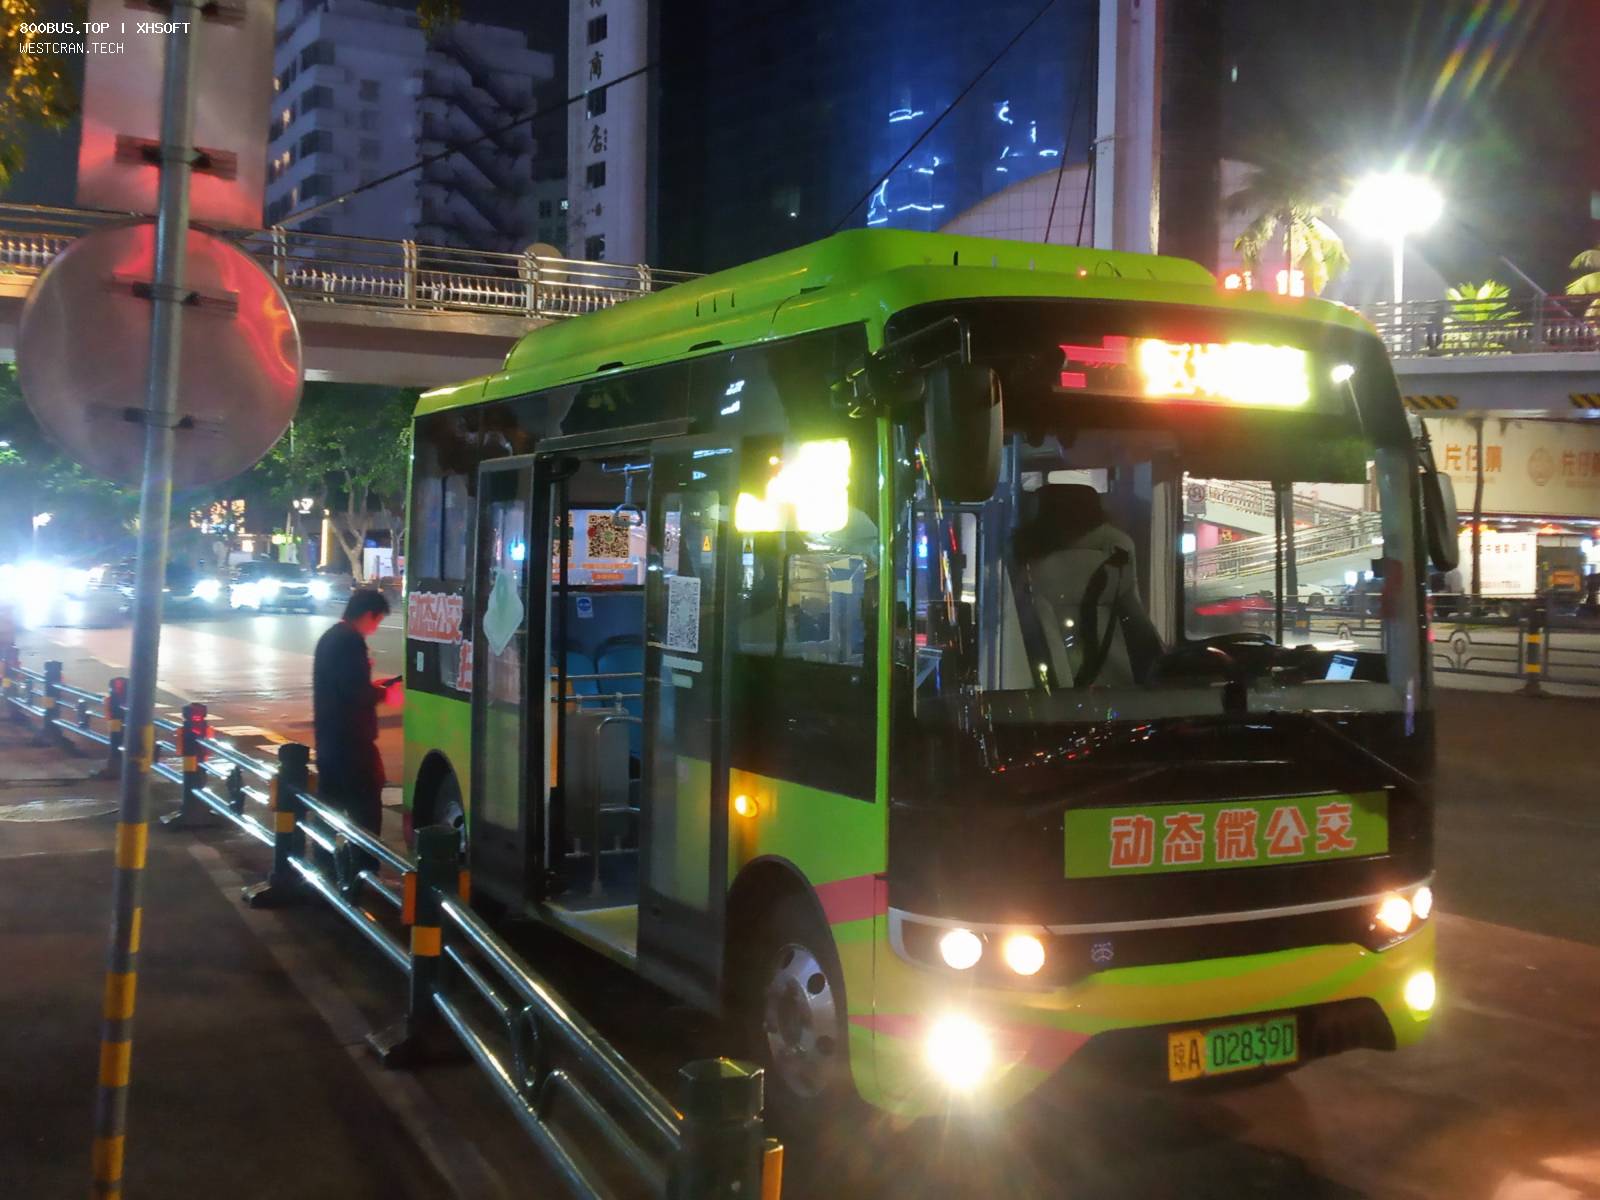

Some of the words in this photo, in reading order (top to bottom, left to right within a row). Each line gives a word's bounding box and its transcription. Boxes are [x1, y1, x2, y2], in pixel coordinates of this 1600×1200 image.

[1110, 803, 1357, 868] 动态微公交
